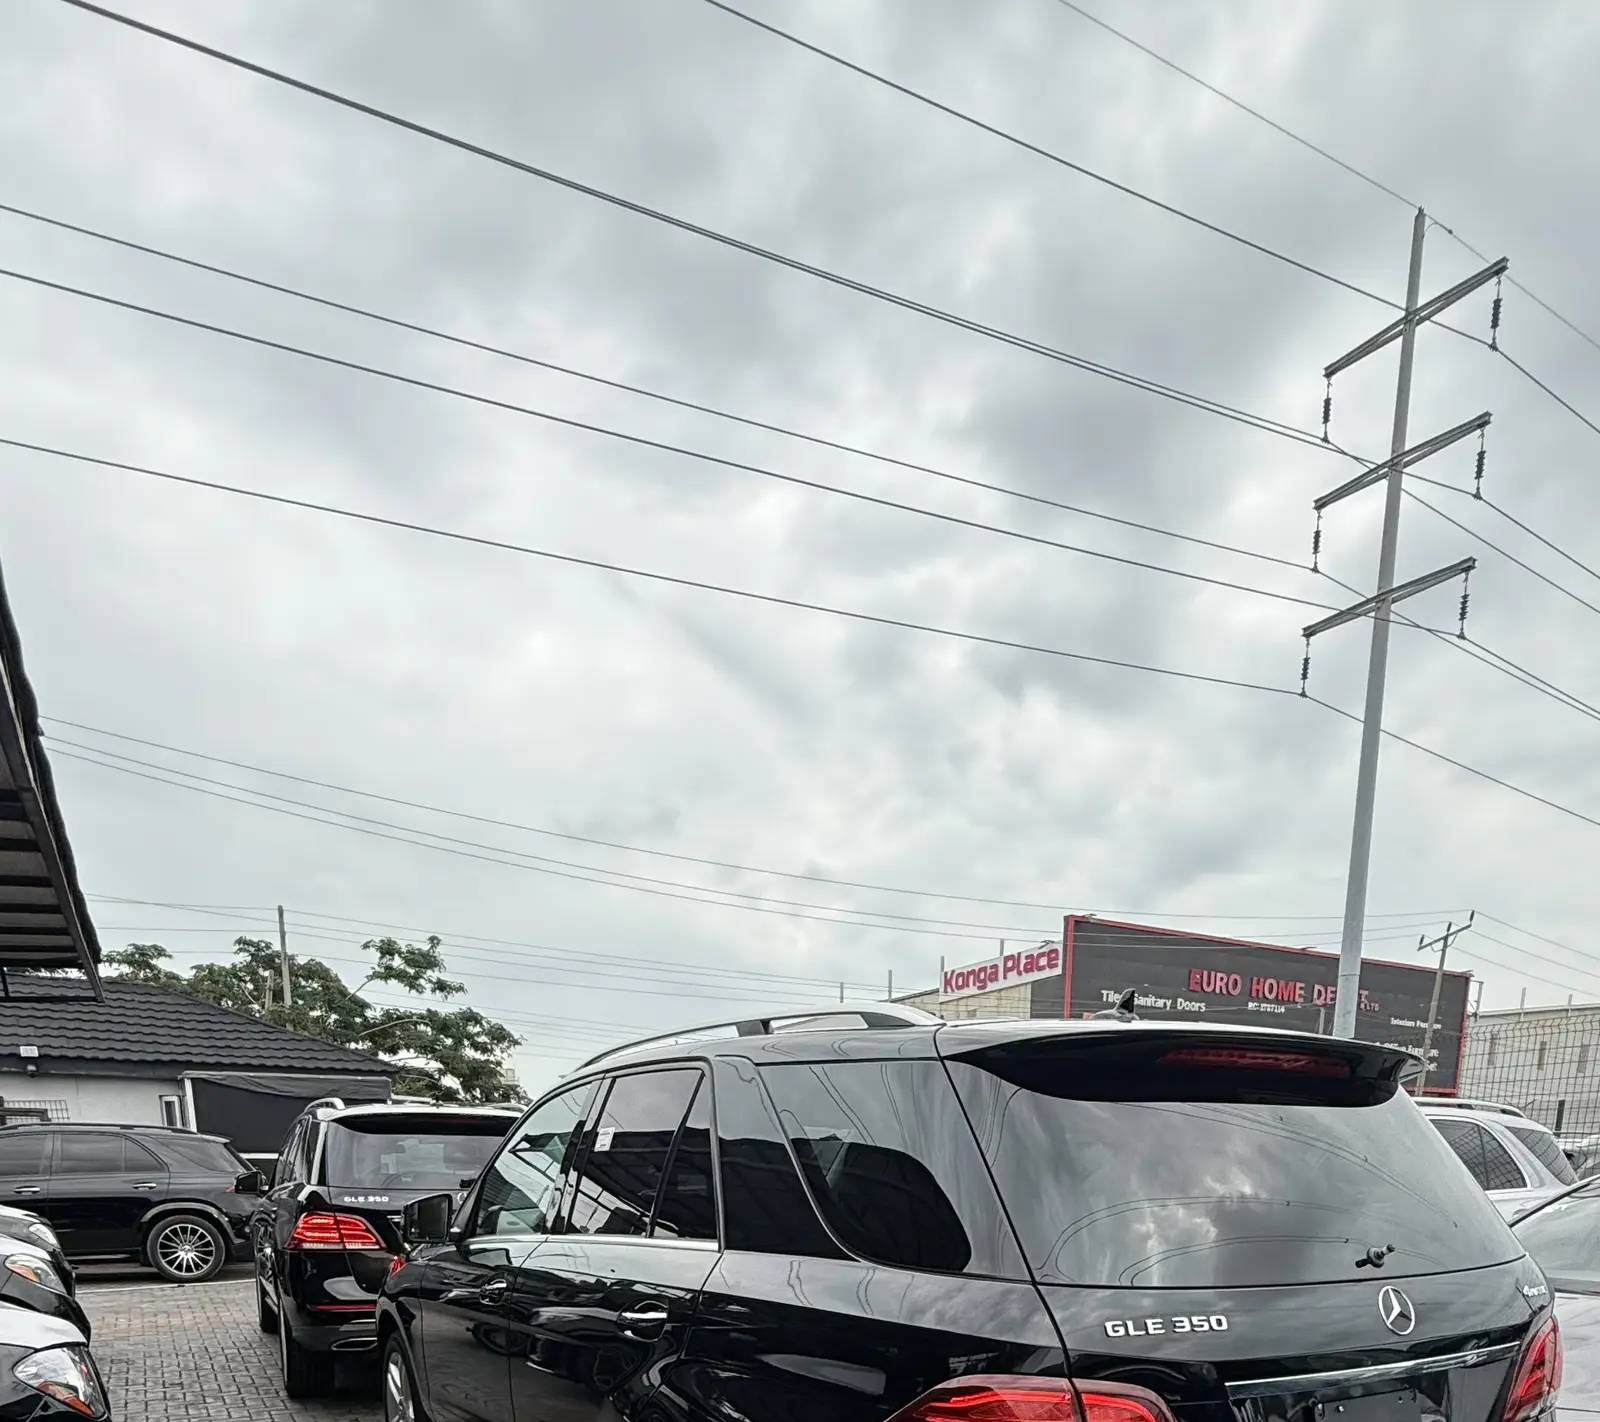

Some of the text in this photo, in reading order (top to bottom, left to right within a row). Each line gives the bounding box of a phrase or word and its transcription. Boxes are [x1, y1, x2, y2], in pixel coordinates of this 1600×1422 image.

[944, 948, 1059, 994] Konga Place
[1101, 990, 1121, 1002] Tile
[1177, 998, 1206, 1012] Doors
[1189, 968, 1369, 1006] EURO HOME DET
[1104, 1315, 1228, 1337] GLE 350
